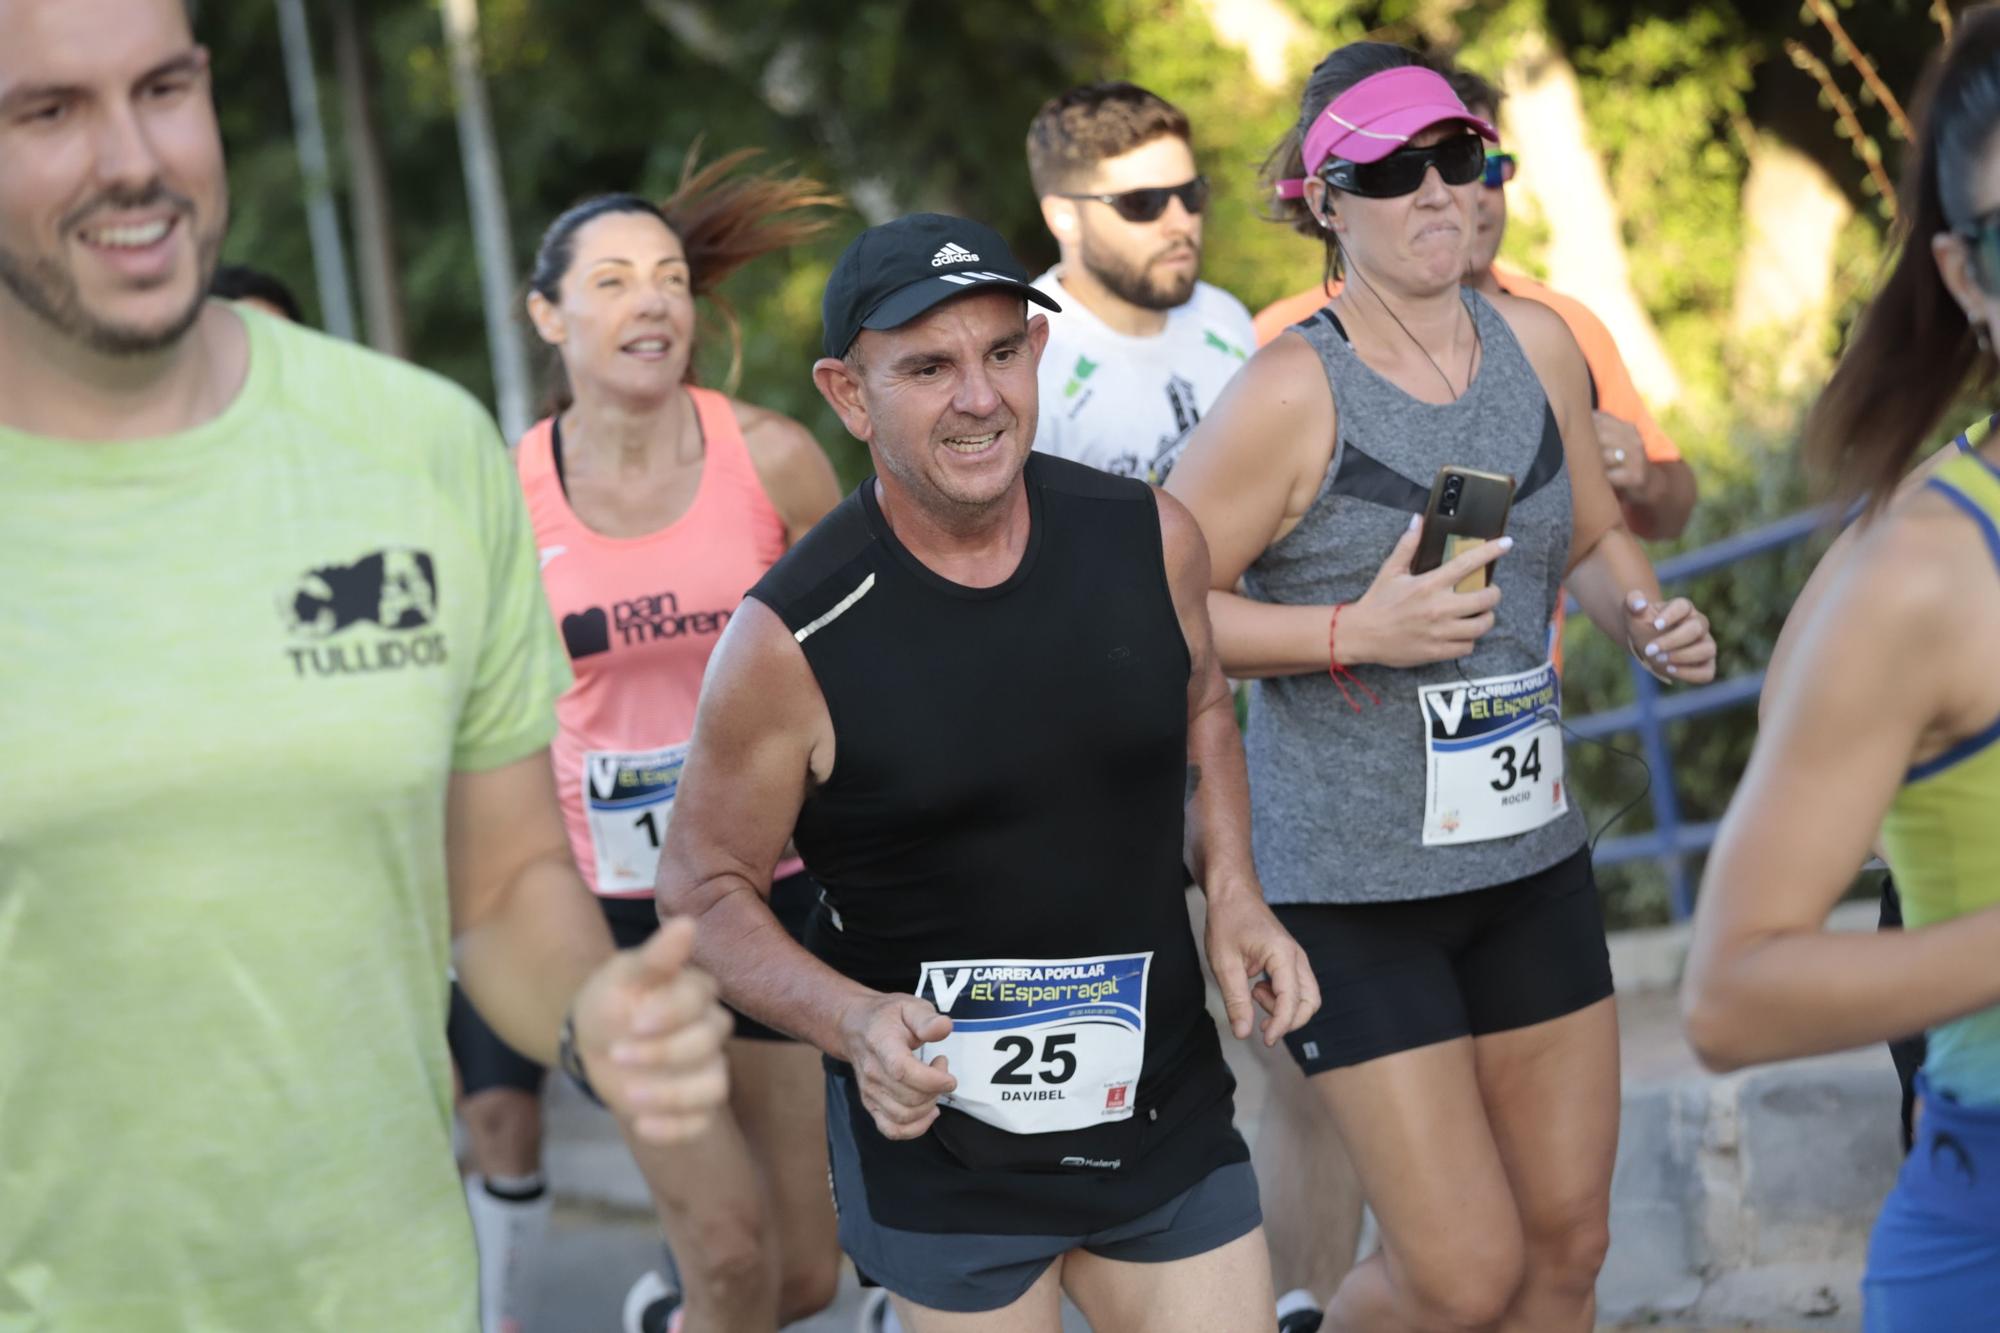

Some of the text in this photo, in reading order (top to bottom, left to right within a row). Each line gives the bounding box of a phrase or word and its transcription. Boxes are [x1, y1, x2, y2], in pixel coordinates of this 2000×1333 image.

[931, 253, 980, 267] adidas
[613, 592, 677, 631] pan
[285, 632, 449, 677] TULLIDOS
[1490, 736, 1541, 791] 34
[929, 969, 972, 1013] V
[971, 976, 1119, 1008] El Esparragal
[973, 964, 1105, 982] CARRERA POPULAR
[990, 1033, 1077, 1085] 25
[1001, 1090, 1066, 1102] DAVIBEL
